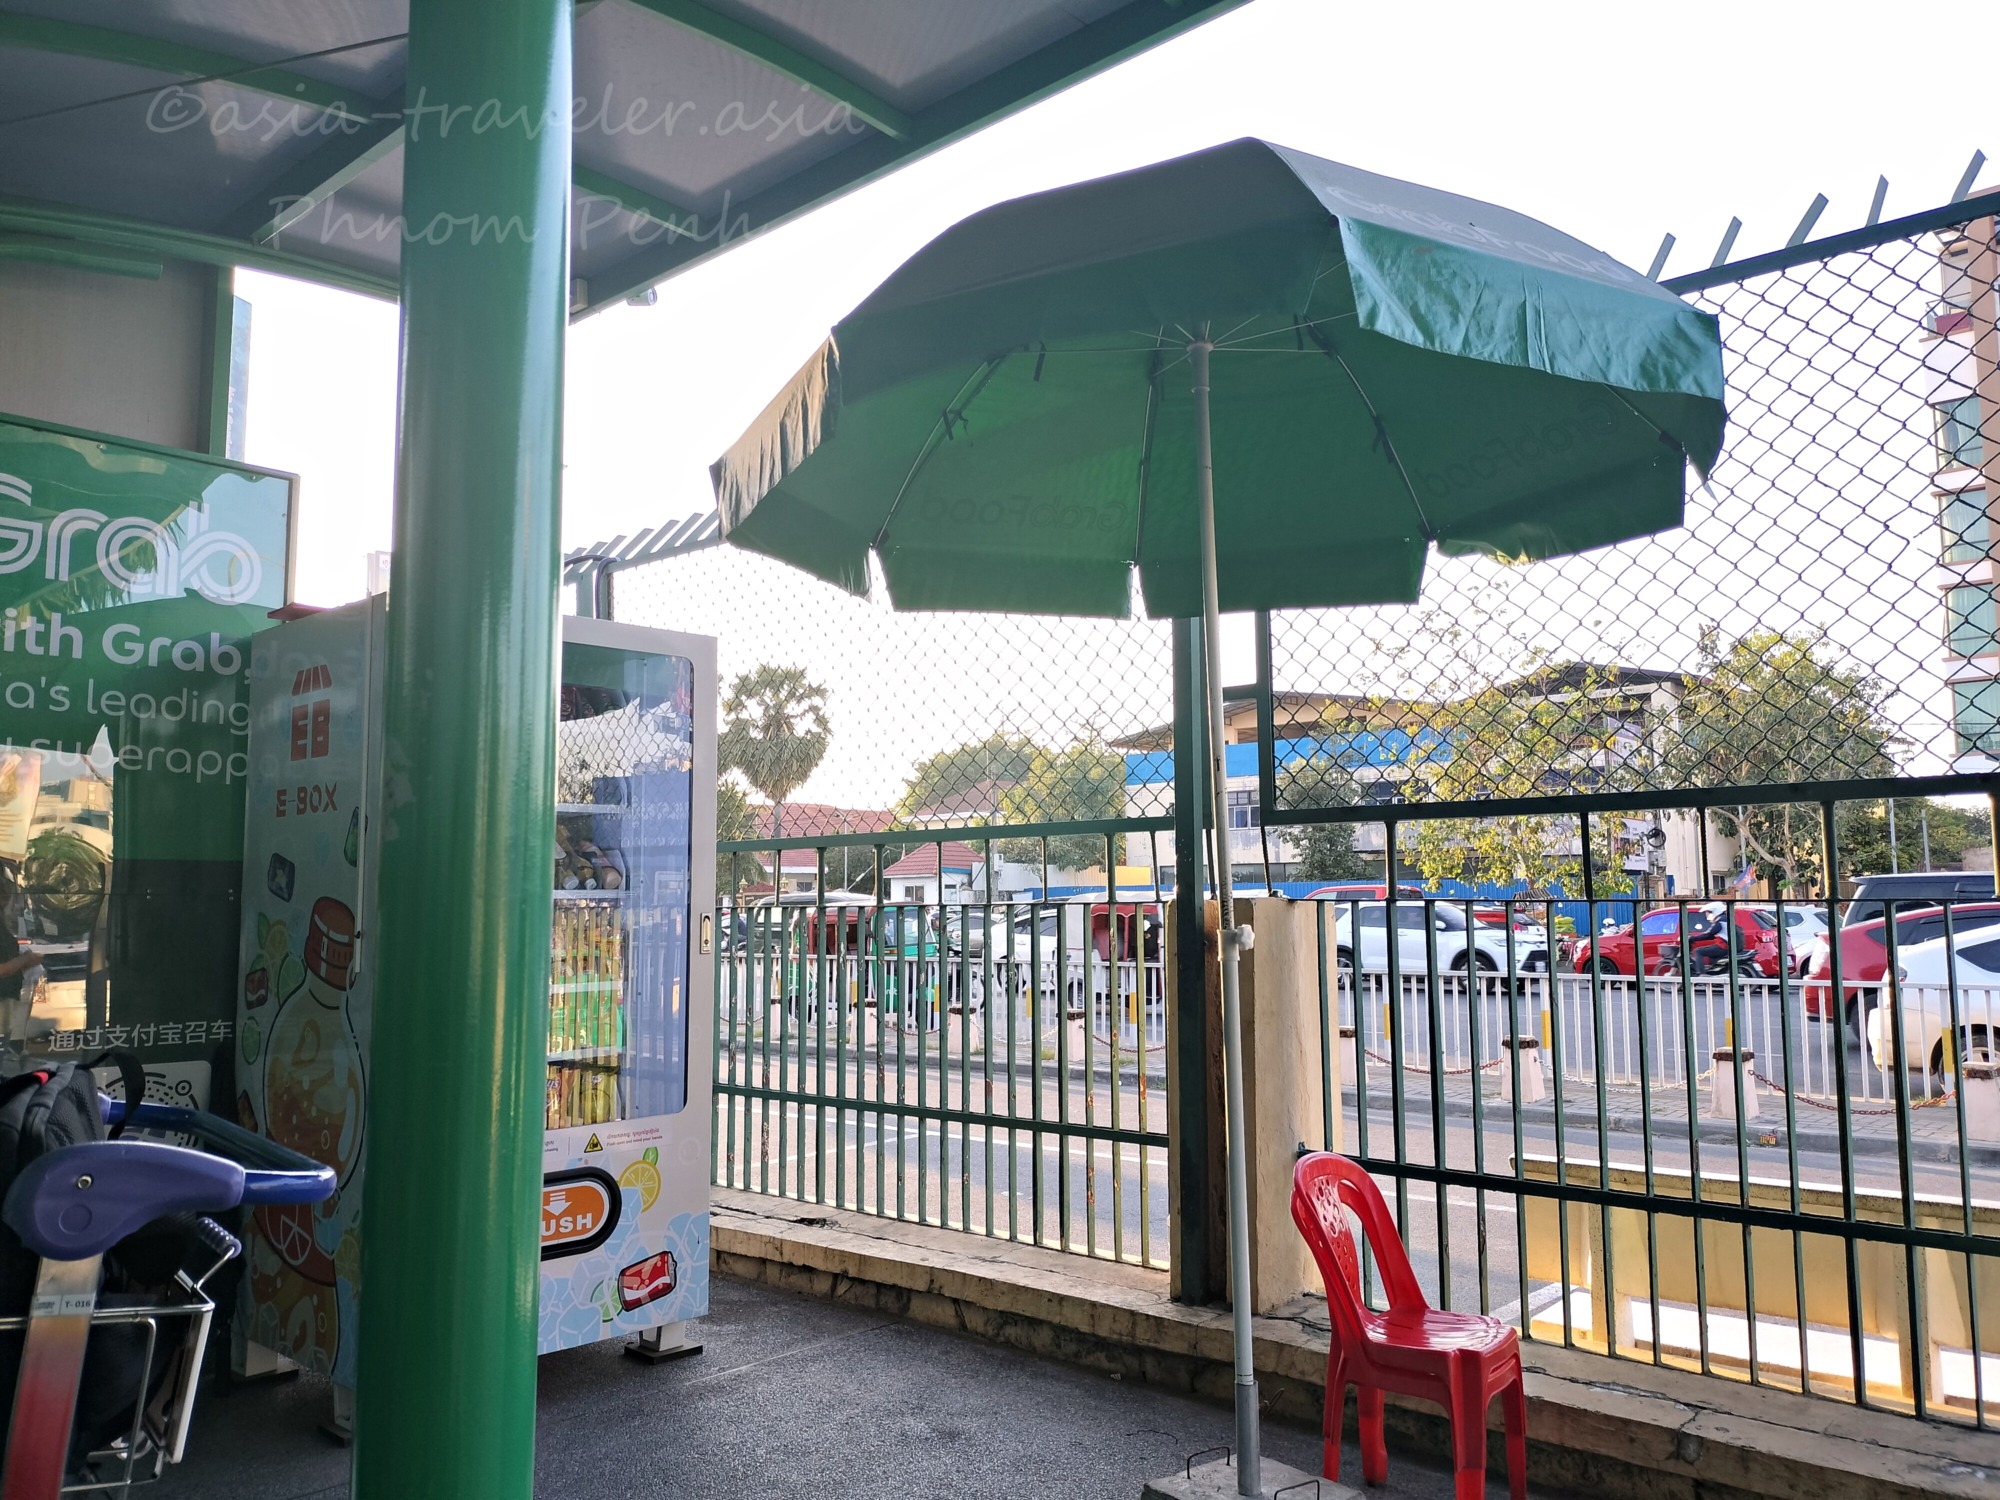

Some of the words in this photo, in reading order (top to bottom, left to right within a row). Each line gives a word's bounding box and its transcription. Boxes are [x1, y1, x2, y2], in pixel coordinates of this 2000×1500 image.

[3, 607, 84, 659] ith
[5, 676, 70, 712] a's
[87, 678, 250, 736] leading
[276, 781, 338, 817] E-BOX
[48, 1019, 233, 1052] 通过支付宝召车
[541, 1213, 593, 1236] USH
